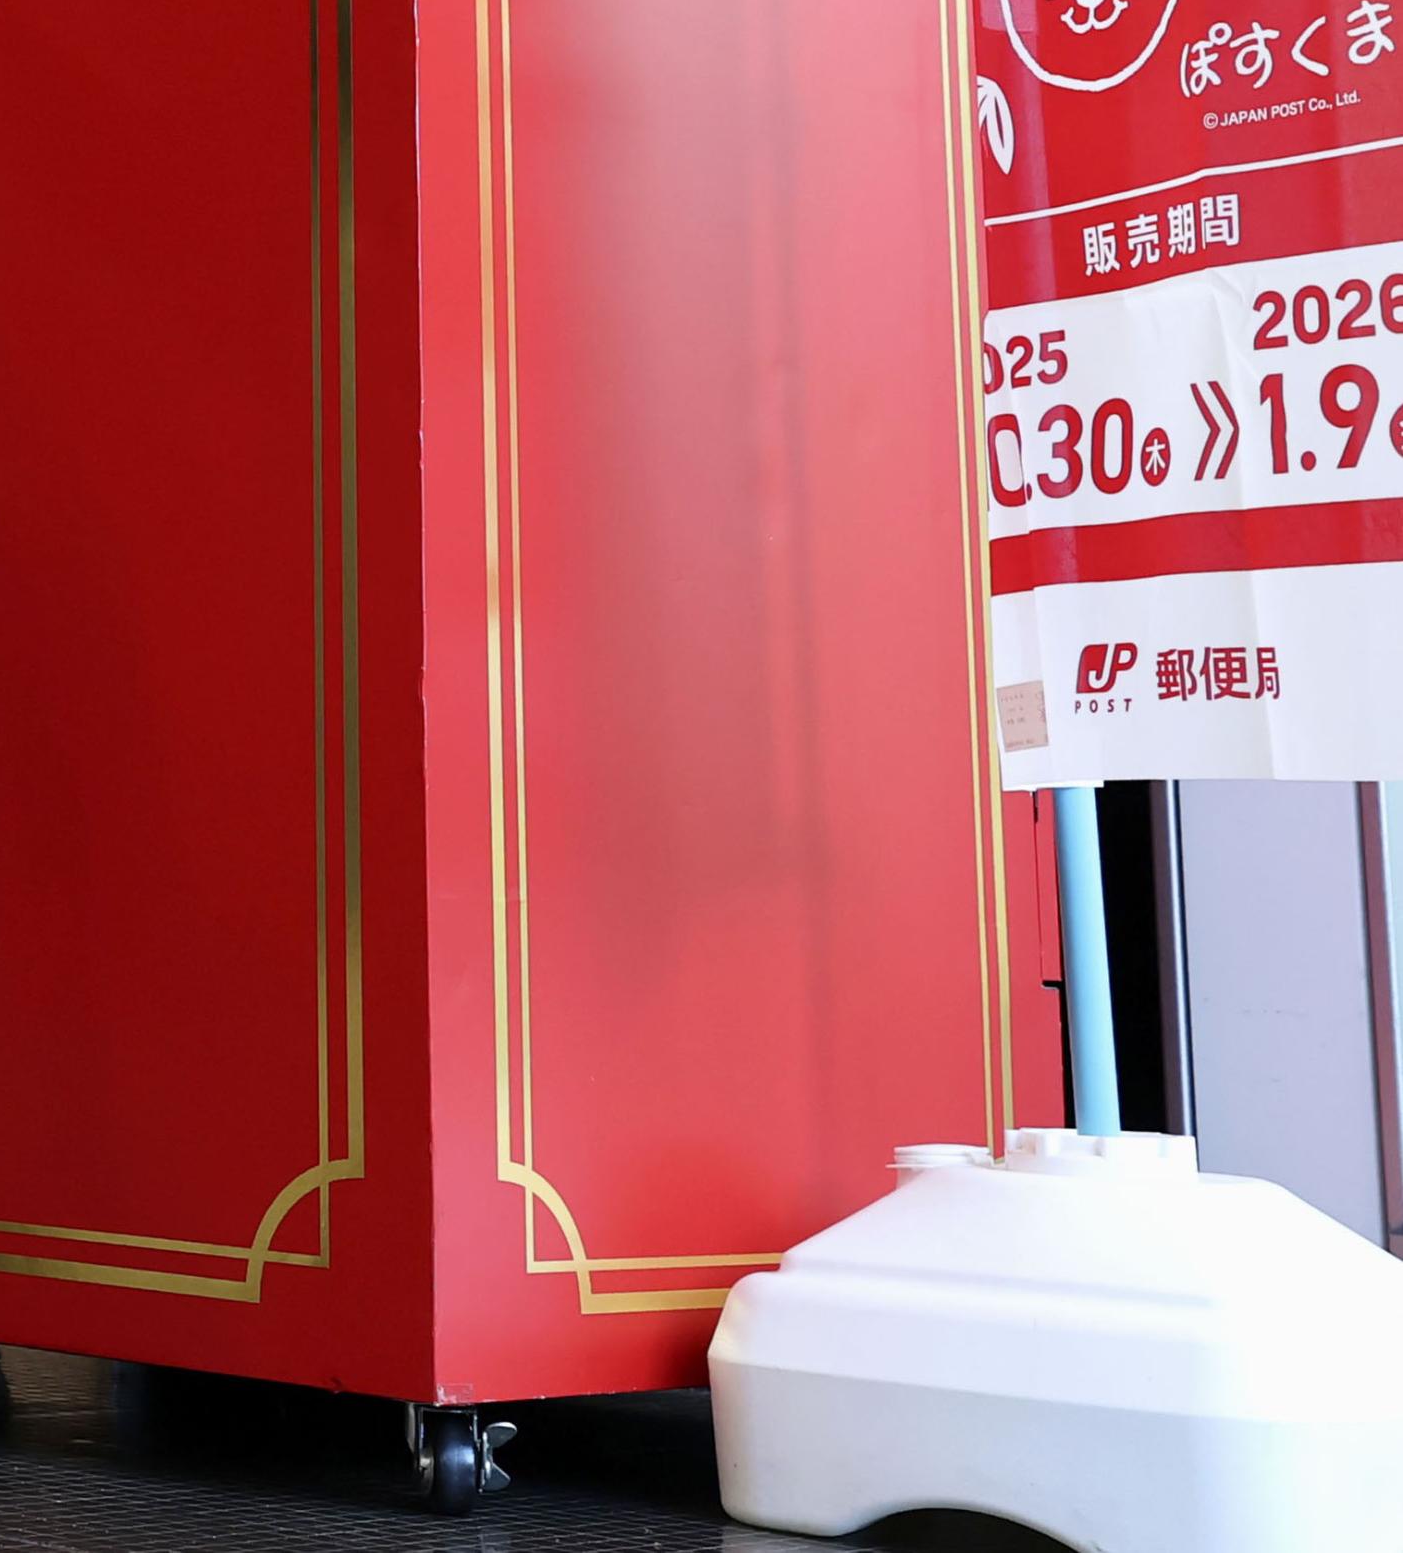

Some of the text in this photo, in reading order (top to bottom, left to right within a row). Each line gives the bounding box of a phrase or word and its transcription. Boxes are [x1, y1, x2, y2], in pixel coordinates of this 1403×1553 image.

[1180, 0, 1396, 98] ぽすくま
[1271, 100, 1306, 119] POST
[1308, 96, 1333, 111] Co.,
[1335, 89, 1361, 107] Ltd.
[1083, 194, 1241, 277] 販売期間
[1253, 272, 1403, 350] 2026
[1074, 698, 1133, 714] POST
[1156, 647, 1281, 702] 郵便局
